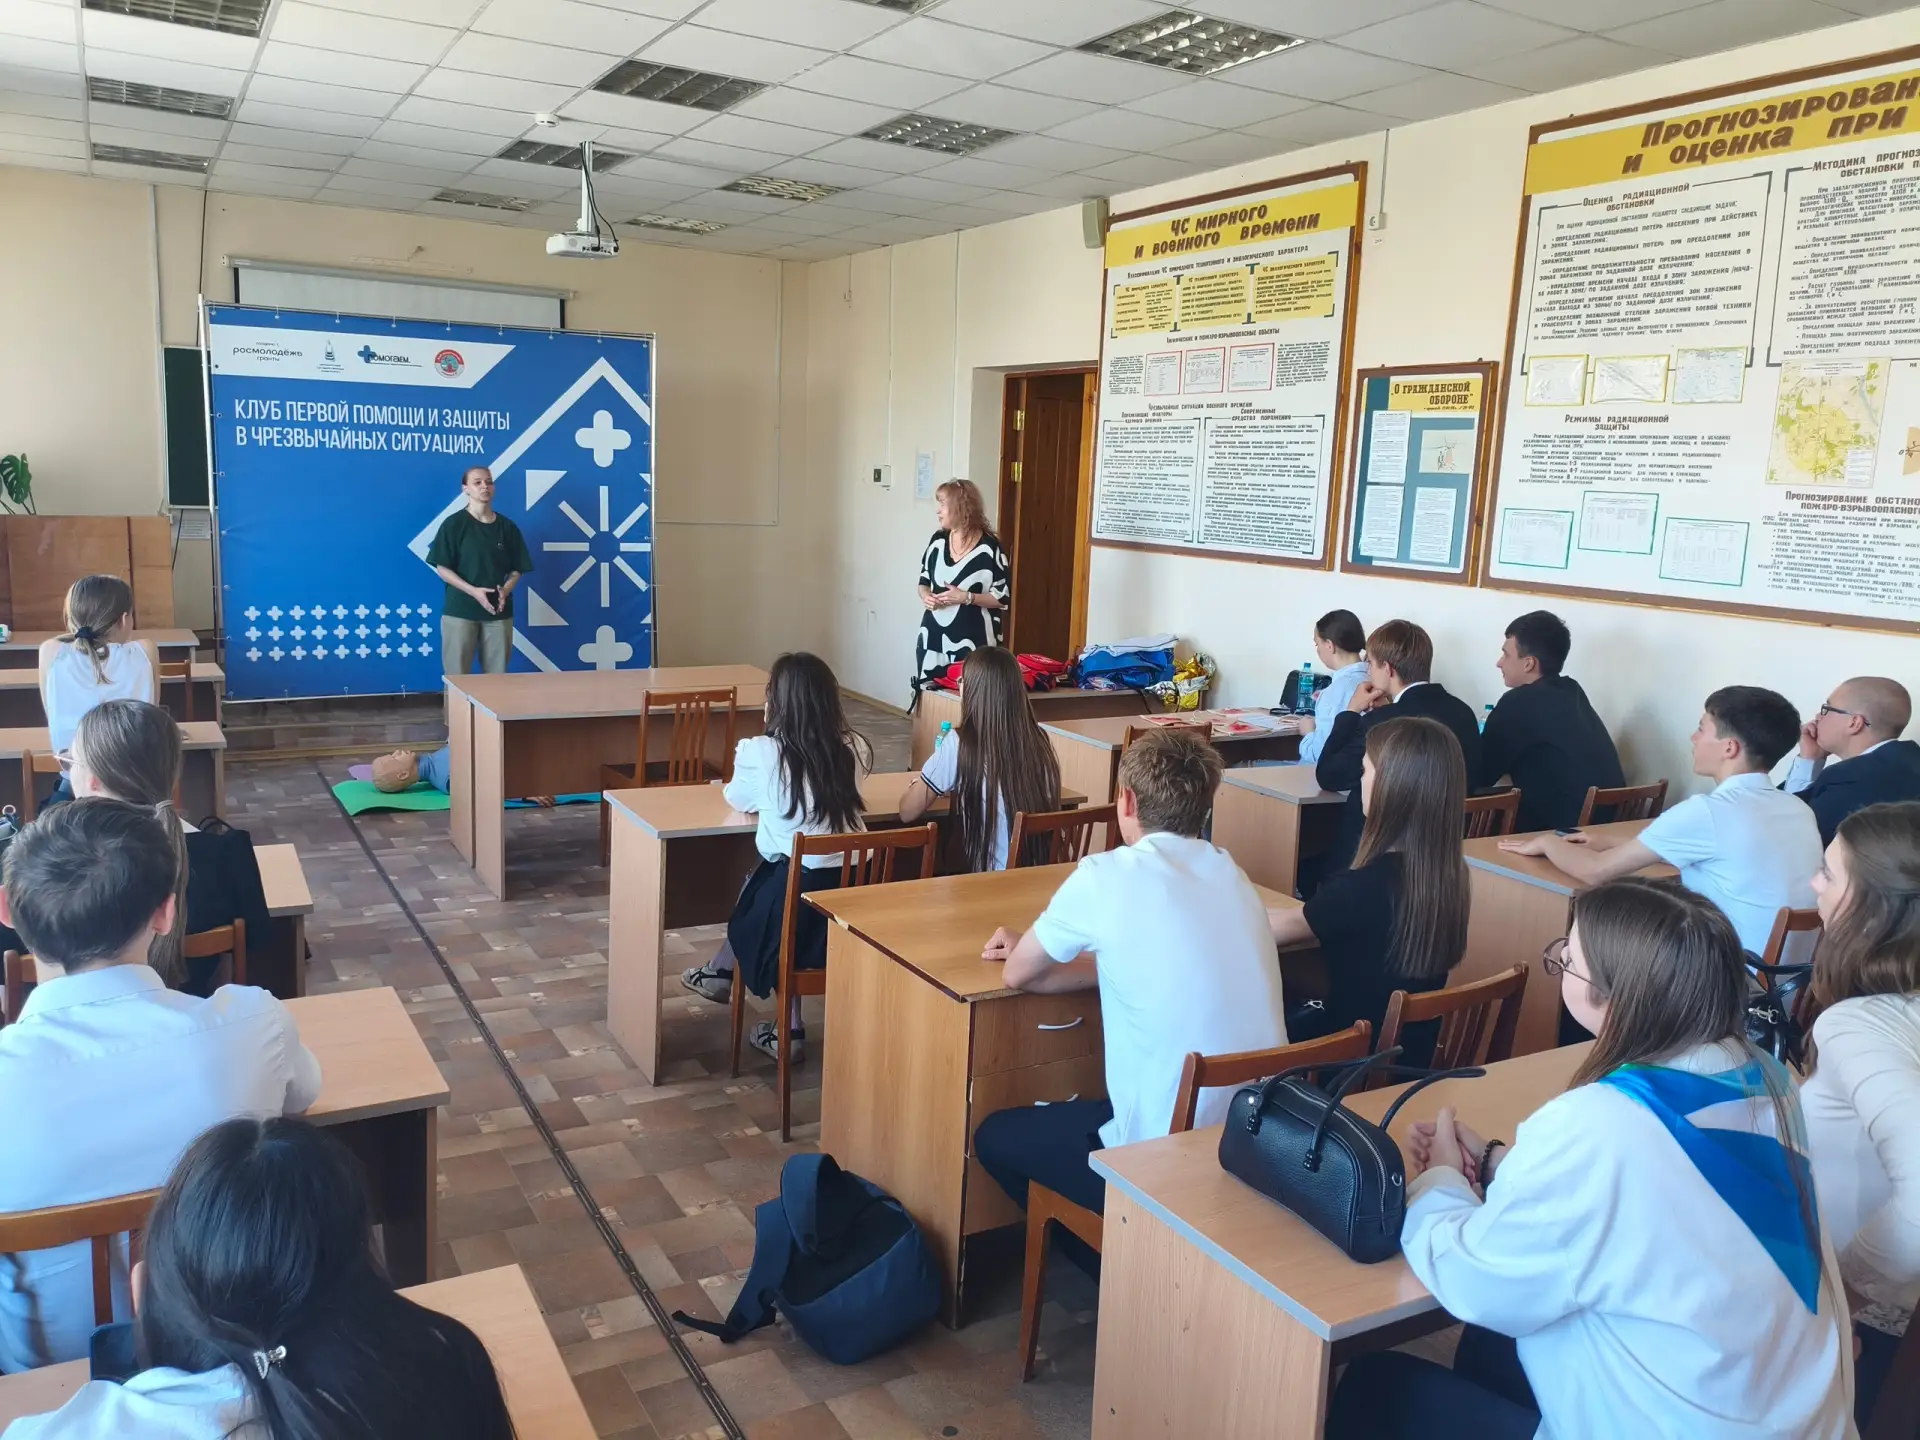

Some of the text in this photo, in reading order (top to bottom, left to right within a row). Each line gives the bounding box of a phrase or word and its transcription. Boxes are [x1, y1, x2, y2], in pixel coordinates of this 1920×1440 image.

[1641, 76, 1920, 148] Прогнозирован
[1813, 156, 1865, 171] МЕТОДИКА
[1841, 162, 1904, 178] ОБСТАНОВКИ
[1171, 218, 1190, 237] ЧС
[1403, 381, 1470, 394] ГРАЖДАНСКОЙ
[234, 399, 510, 430] КЛУБ ПЕРВОЙ ПОМОЩИ И ЗАЩИТЫ
[1565, 414, 1669, 424] РЕЖИМЫ РАДИАЦИОННОЙ
[236, 426, 484, 454] В ЧРЕЗВЫЧАЙНЫХ СИТУАЦИЯХ
[1786, 491, 1868, 504] ПРОГНОЗИРОВАНИЕ
